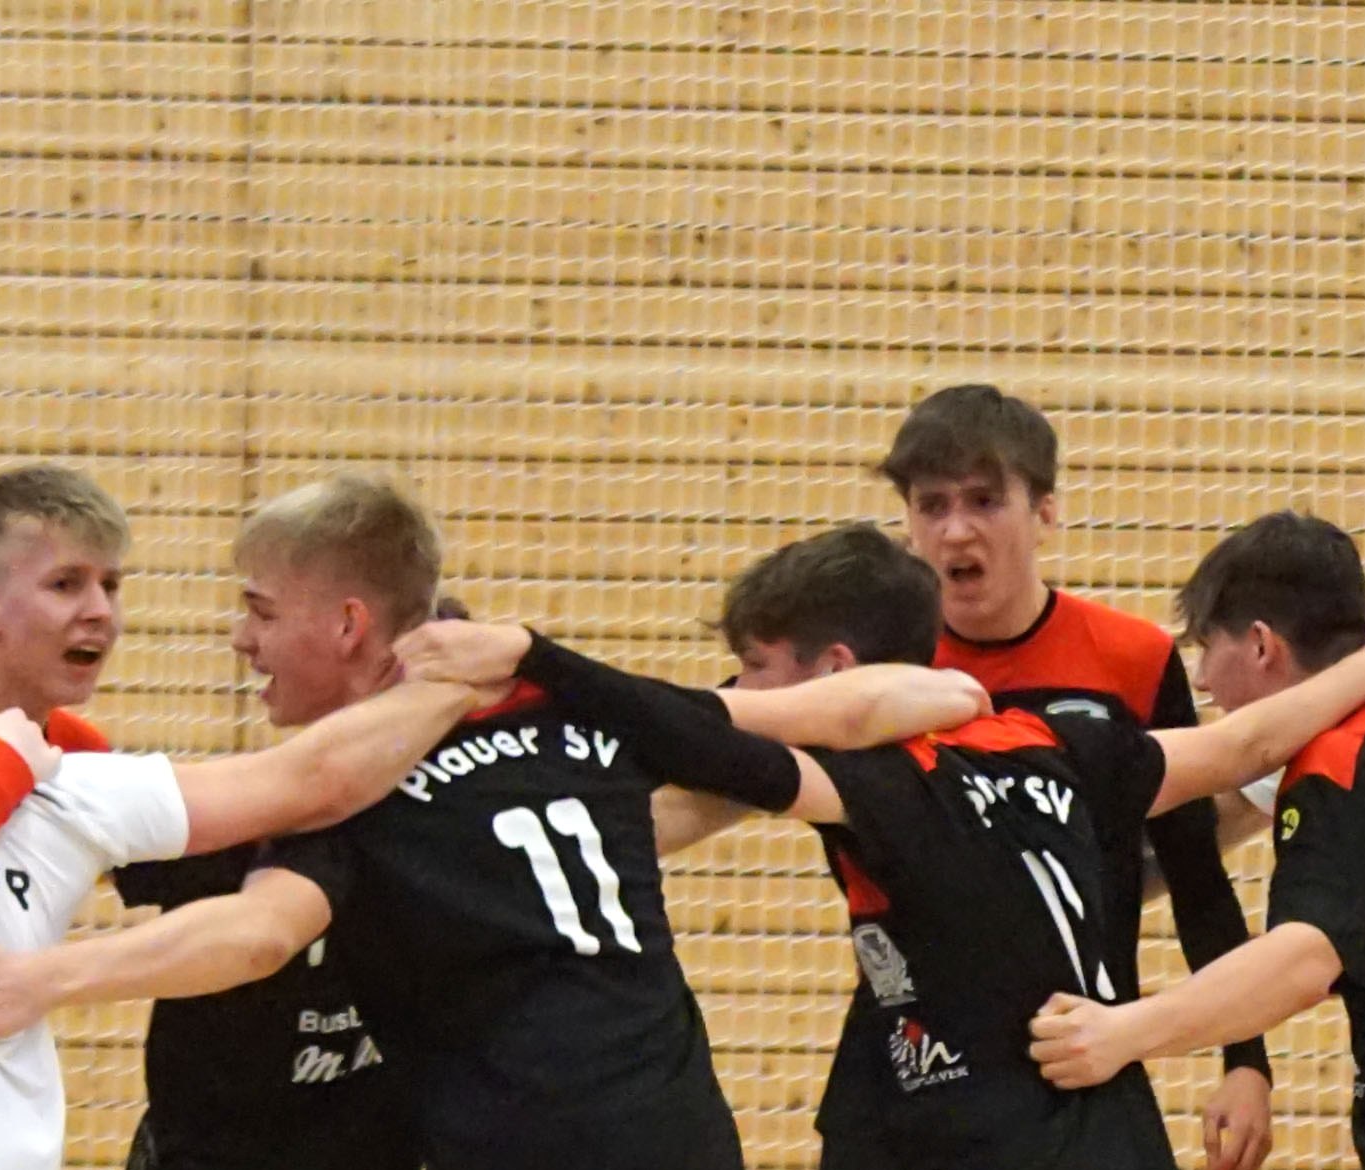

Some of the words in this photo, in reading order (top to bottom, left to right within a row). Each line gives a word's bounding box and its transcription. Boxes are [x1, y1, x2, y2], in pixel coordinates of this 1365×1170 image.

[397, 726, 540, 803] Plauer
[563, 723, 620, 769] SV
[492, 796, 643, 957] 11
